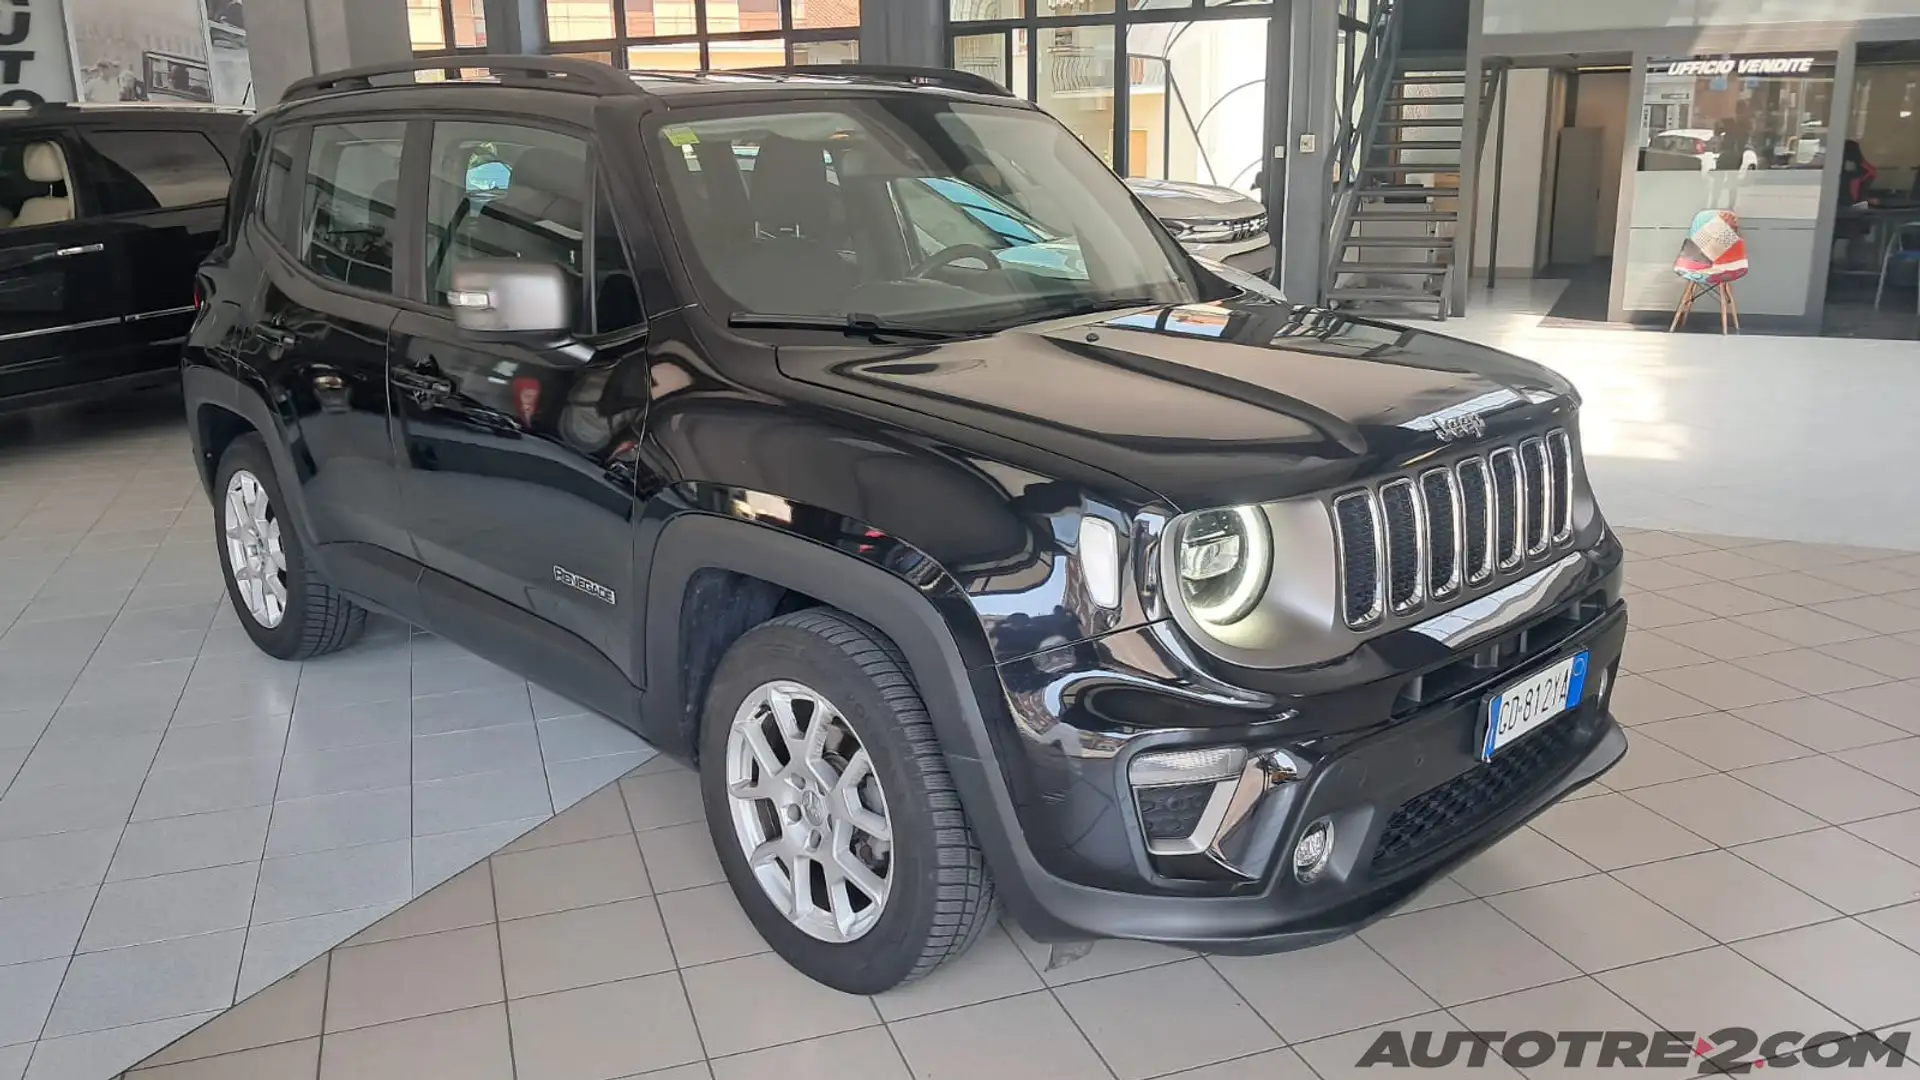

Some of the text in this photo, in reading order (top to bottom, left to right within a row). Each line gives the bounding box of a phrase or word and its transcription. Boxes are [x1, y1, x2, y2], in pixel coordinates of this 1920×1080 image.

[1667, 57, 1814, 76] UFFICIO VENDITE
[1432, 412, 1486, 442] Jeep
[553, 565, 616, 605] RENEGADE
